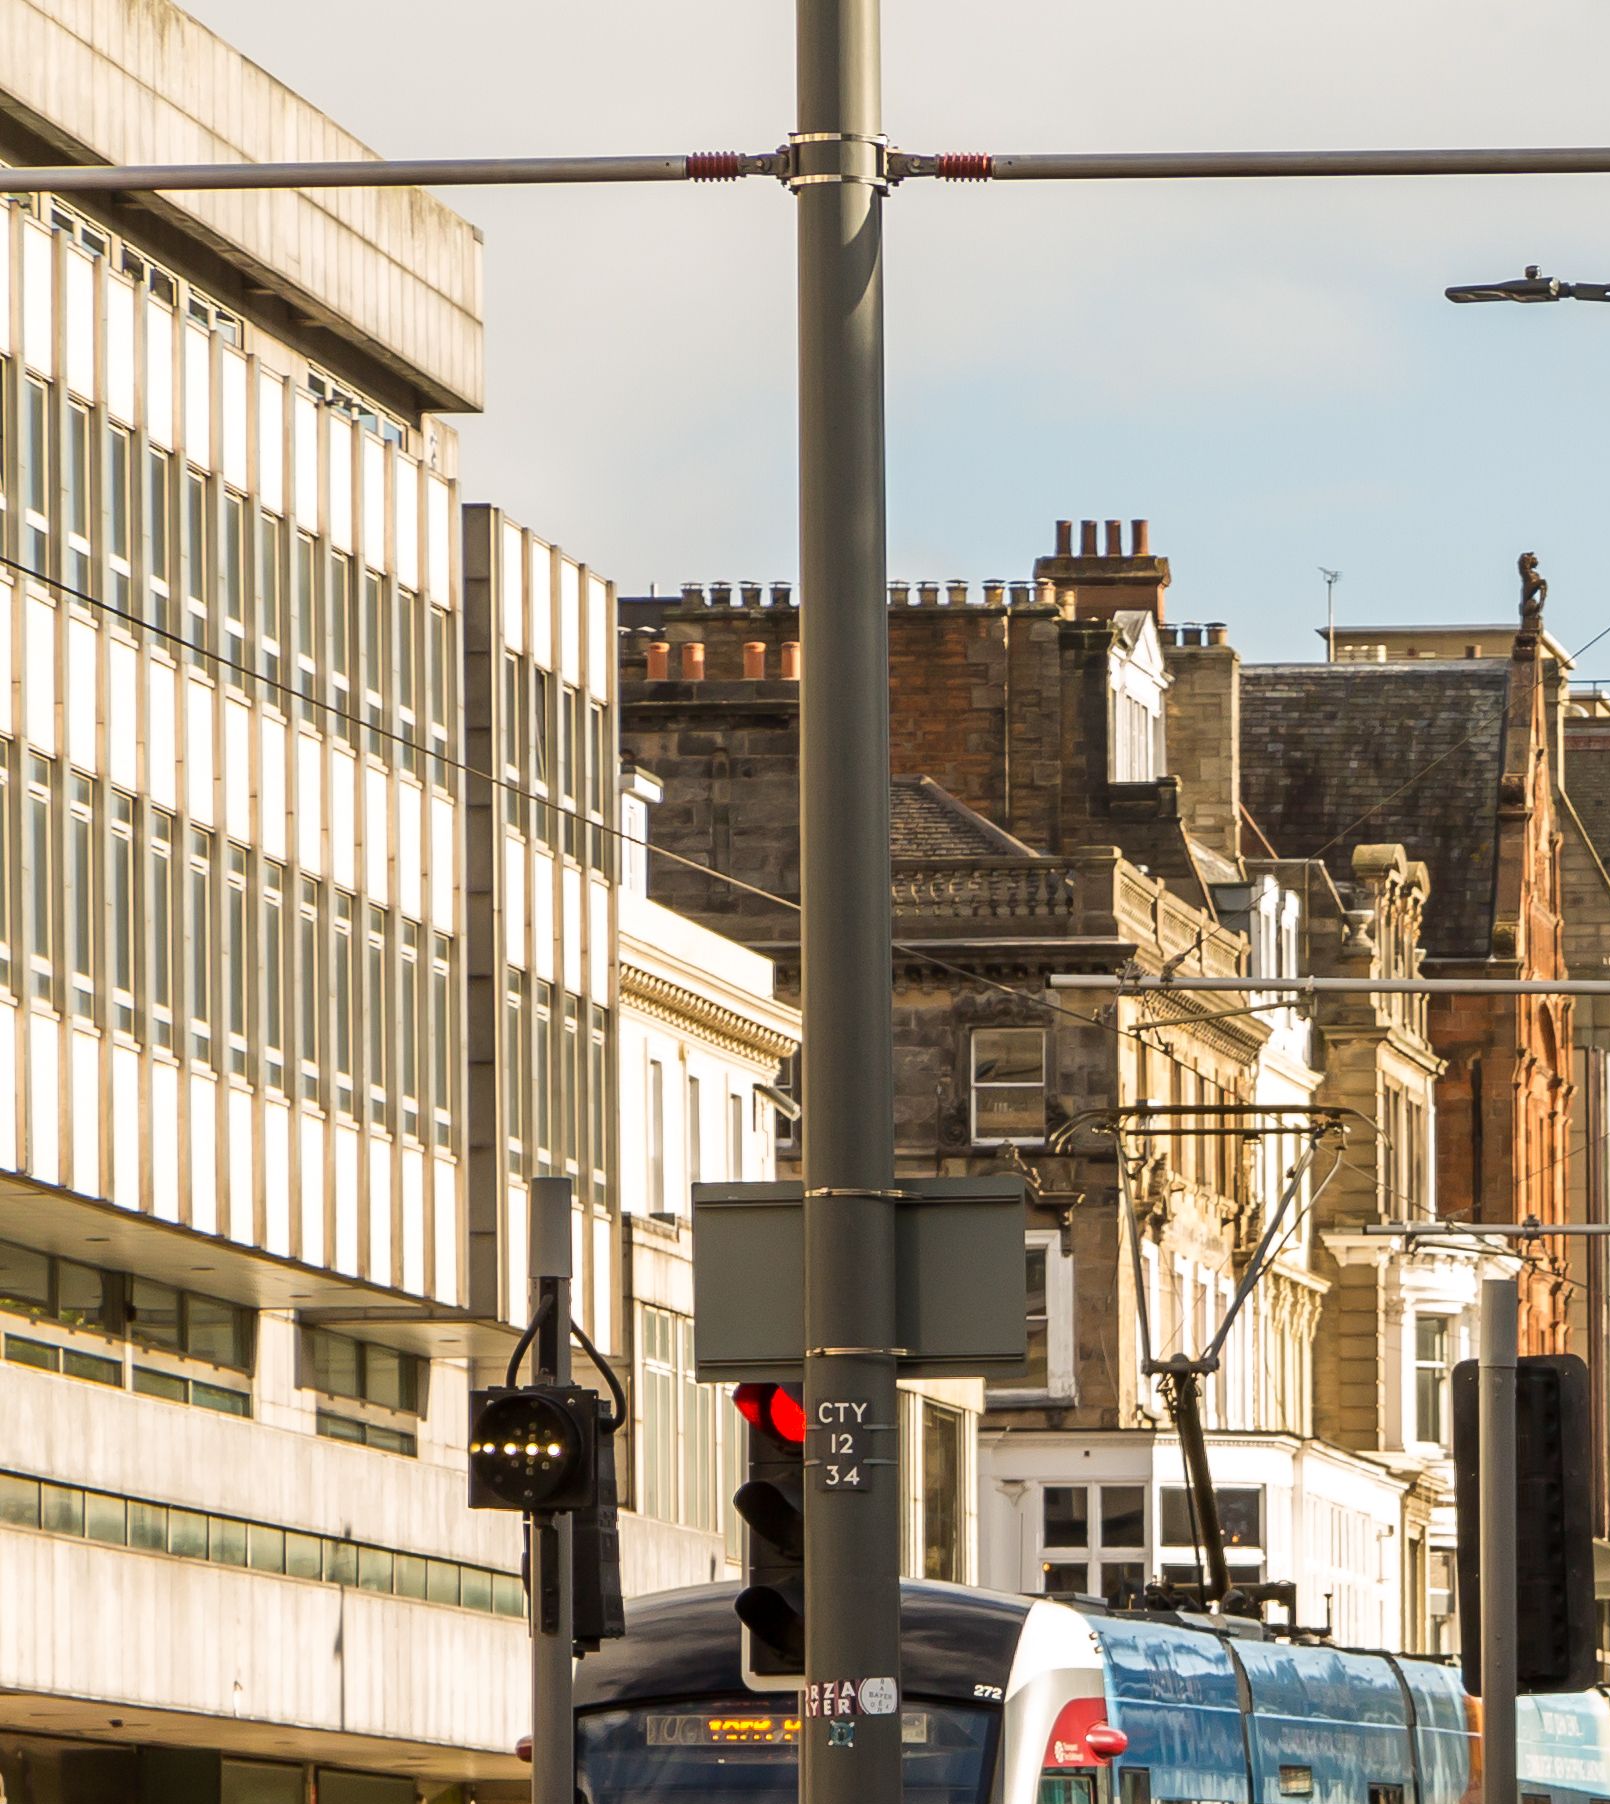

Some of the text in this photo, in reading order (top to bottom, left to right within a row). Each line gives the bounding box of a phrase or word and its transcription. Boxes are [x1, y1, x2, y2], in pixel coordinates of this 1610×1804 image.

[818, 1402, 867, 1424] CTY
[831, 1433, 853, 1454] 12
[825, 1465, 860, 1486] 34
[973, 1684, 1002, 1699] 272
